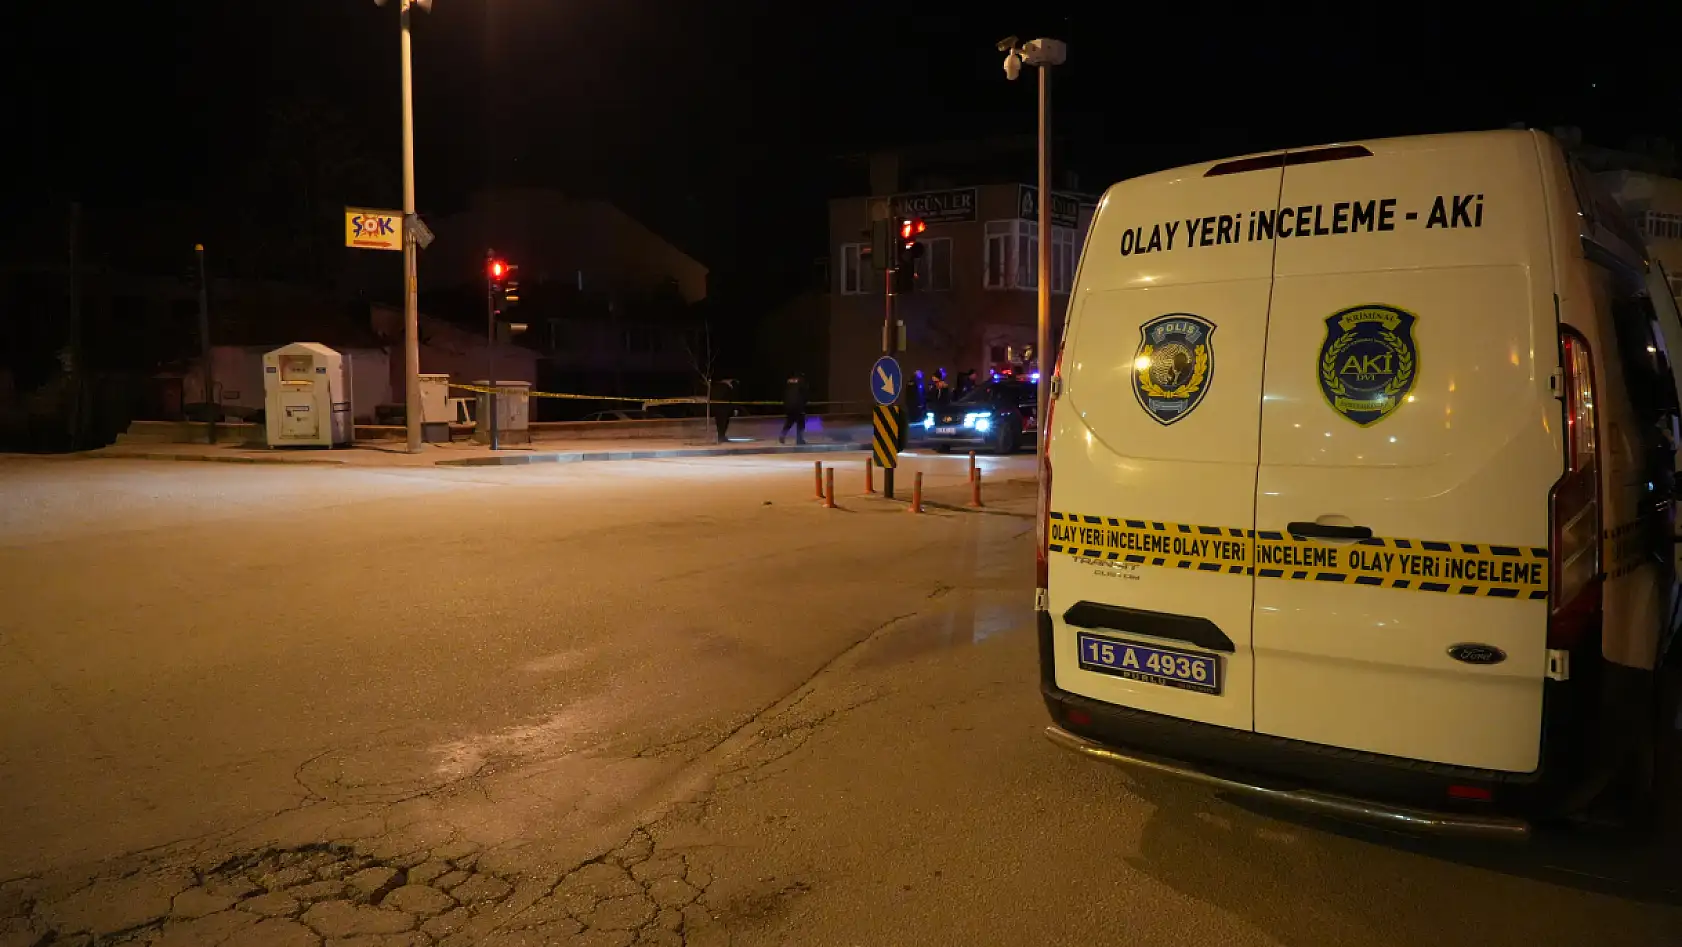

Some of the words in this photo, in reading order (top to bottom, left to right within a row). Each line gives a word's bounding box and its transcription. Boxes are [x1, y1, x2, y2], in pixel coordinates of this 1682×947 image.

[352, 216, 395, 238] ŞOK
[1120, 221, 1179, 256] OLAY
[1052, 524, 1077, 542] OLAY
[1173, 537, 1210, 558] OLAY
[1348, 550, 1393, 573] OLAY
[1089, 642, 1115, 664] 15
[1122, 648, 1139, 669] A
[1146, 653, 1207, 681] 4936
